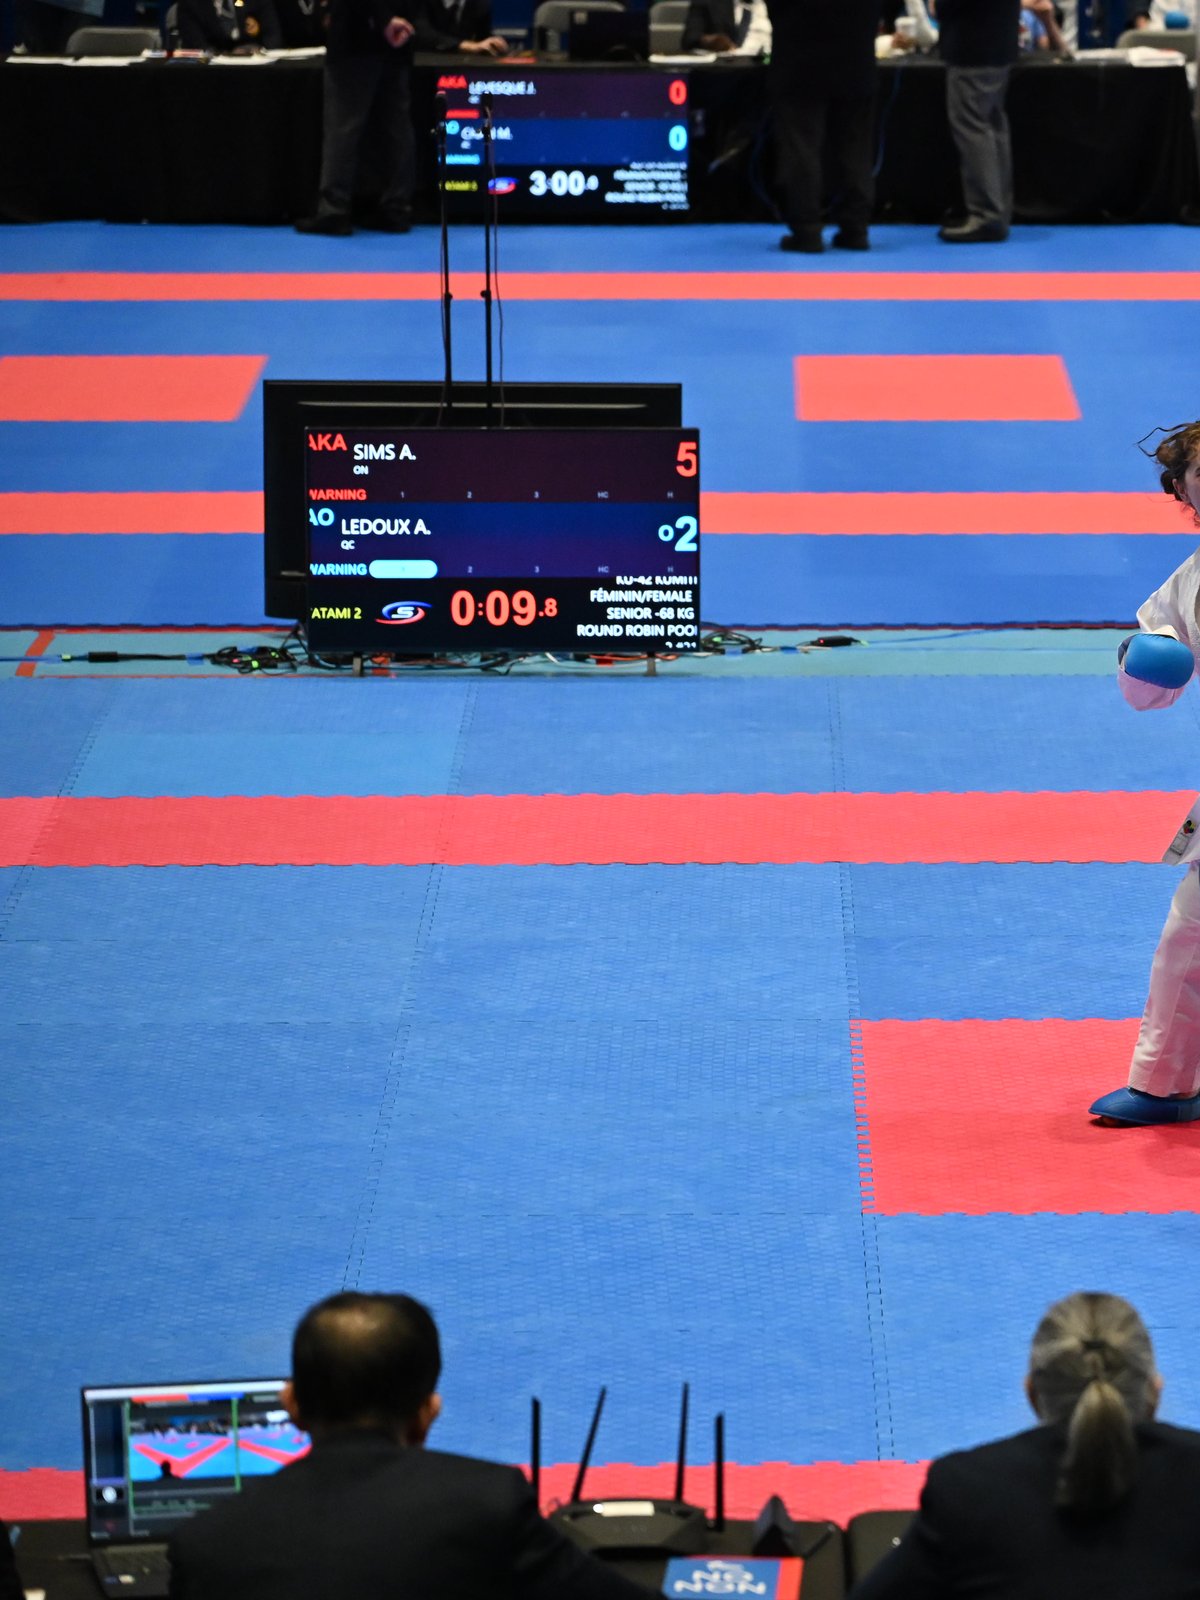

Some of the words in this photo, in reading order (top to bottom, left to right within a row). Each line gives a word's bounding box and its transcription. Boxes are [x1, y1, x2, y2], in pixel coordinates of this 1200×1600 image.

[668, 80, 687, 105] 0
[668, 125, 688, 151] 0
[353, 443, 396, 461] SIMS
[399, 443, 417, 461] A.
[676, 441, 697, 478] 5
[353, 465, 369, 475] ON
[342, 518, 411, 535] LEDOUX
[413, 518, 431, 535] A.
[340, 540, 355, 550] QC
[590, 587, 693, 603] FÉMININ/FEMALE
[310, 607, 351, 619] ATAMI
[354, 607, 362, 619] 2
[606, 607, 653, 620] SENIOR
[655, 607, 675, 620] -68
[677, 607, 695, 620] KG
[576, 624, 624, 637] ROUND
[625, 624, 665, 637] ROBIN
